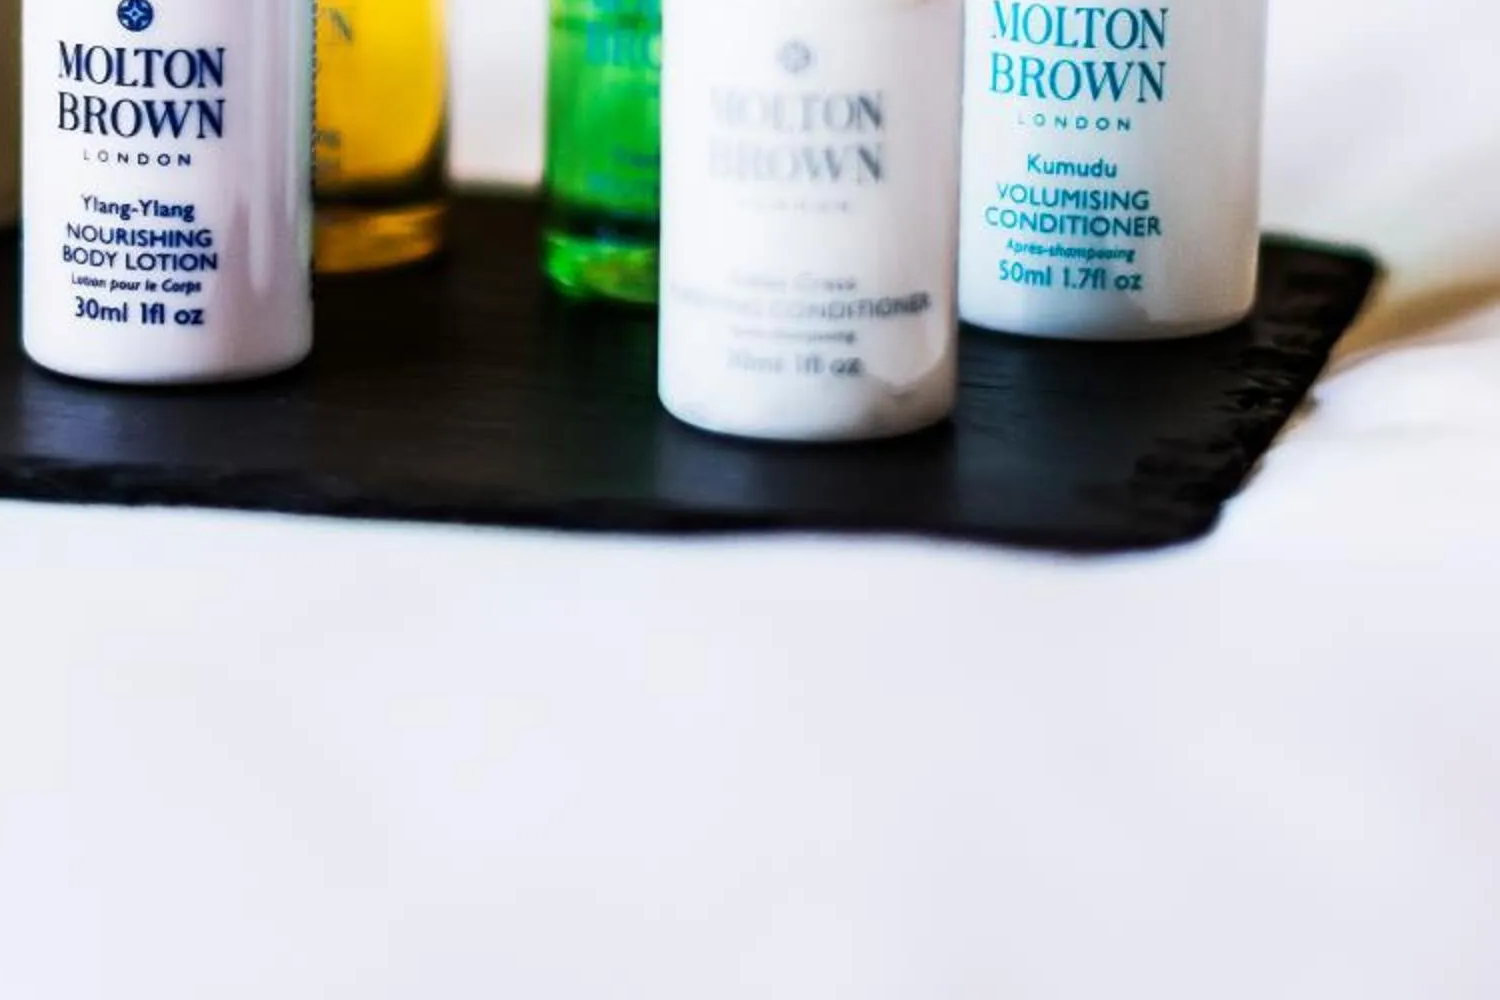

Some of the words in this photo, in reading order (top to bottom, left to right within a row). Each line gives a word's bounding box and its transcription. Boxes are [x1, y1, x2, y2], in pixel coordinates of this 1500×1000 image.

[57, 39, 226, 89] MOLTON
[988, 51, 1167, 103] BROWN
[57, 91, 226, 139] BROWN
[1017, 111, 1132, 132] LONDON
[83, 149, 192, 167] LONDON
[1026, 152, 1118, 179] Kumudu
[80, 194, 196, 223] Ylang-Ylang
[997, 181, 1151, 211] VOLUMISING
[67, 222, 214, 248] NOURISHING
[984, 206, 1162, 238] CONDITIONER
[62, 244, 117, 268] BODY
[125, 252, 218, 272] LOTION
[71, 272, 107, 288] Lotion
[110, 280, 141, 292] pour
[145, 279, 157, 292] le
[161, 279, 202, 296] Corps
[998, 259, 1052, 288] 50ml
[1114, 272, 1144, 291] oz
[74, 295, 128, 323] 30ml
[174, 308, 205, 326] oz
